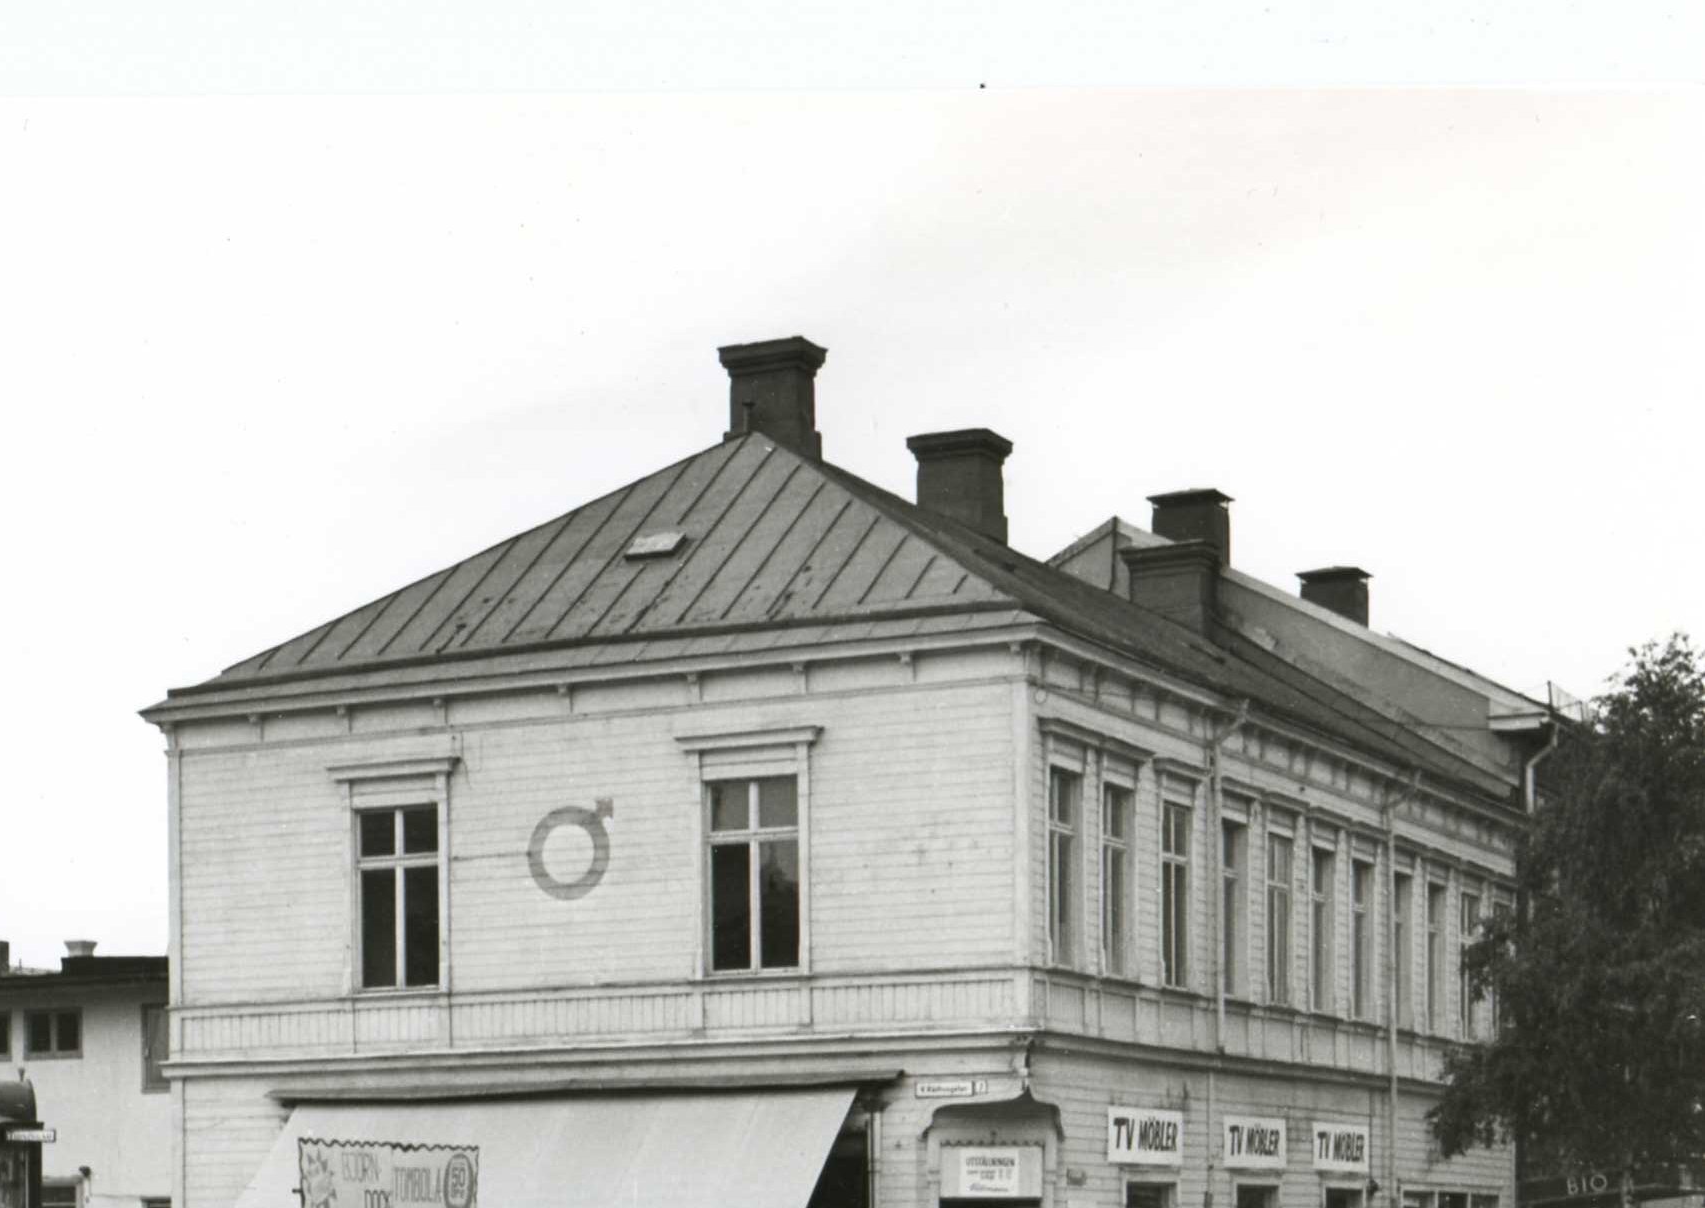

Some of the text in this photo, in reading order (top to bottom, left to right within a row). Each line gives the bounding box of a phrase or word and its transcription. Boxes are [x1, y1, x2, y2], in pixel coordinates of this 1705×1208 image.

[1113, 1115, 1178, 1152] TV MÖBLER
[1229, 1123, 1280, 1157] TV MÖBLER
[1317, 1130, 1331, 1160] TV
[391, 1166, 442, 1203] TOMBOLA
[451, 1166, 467, 1188] 50
[1566, 1174, 1608, 1195] BIO
